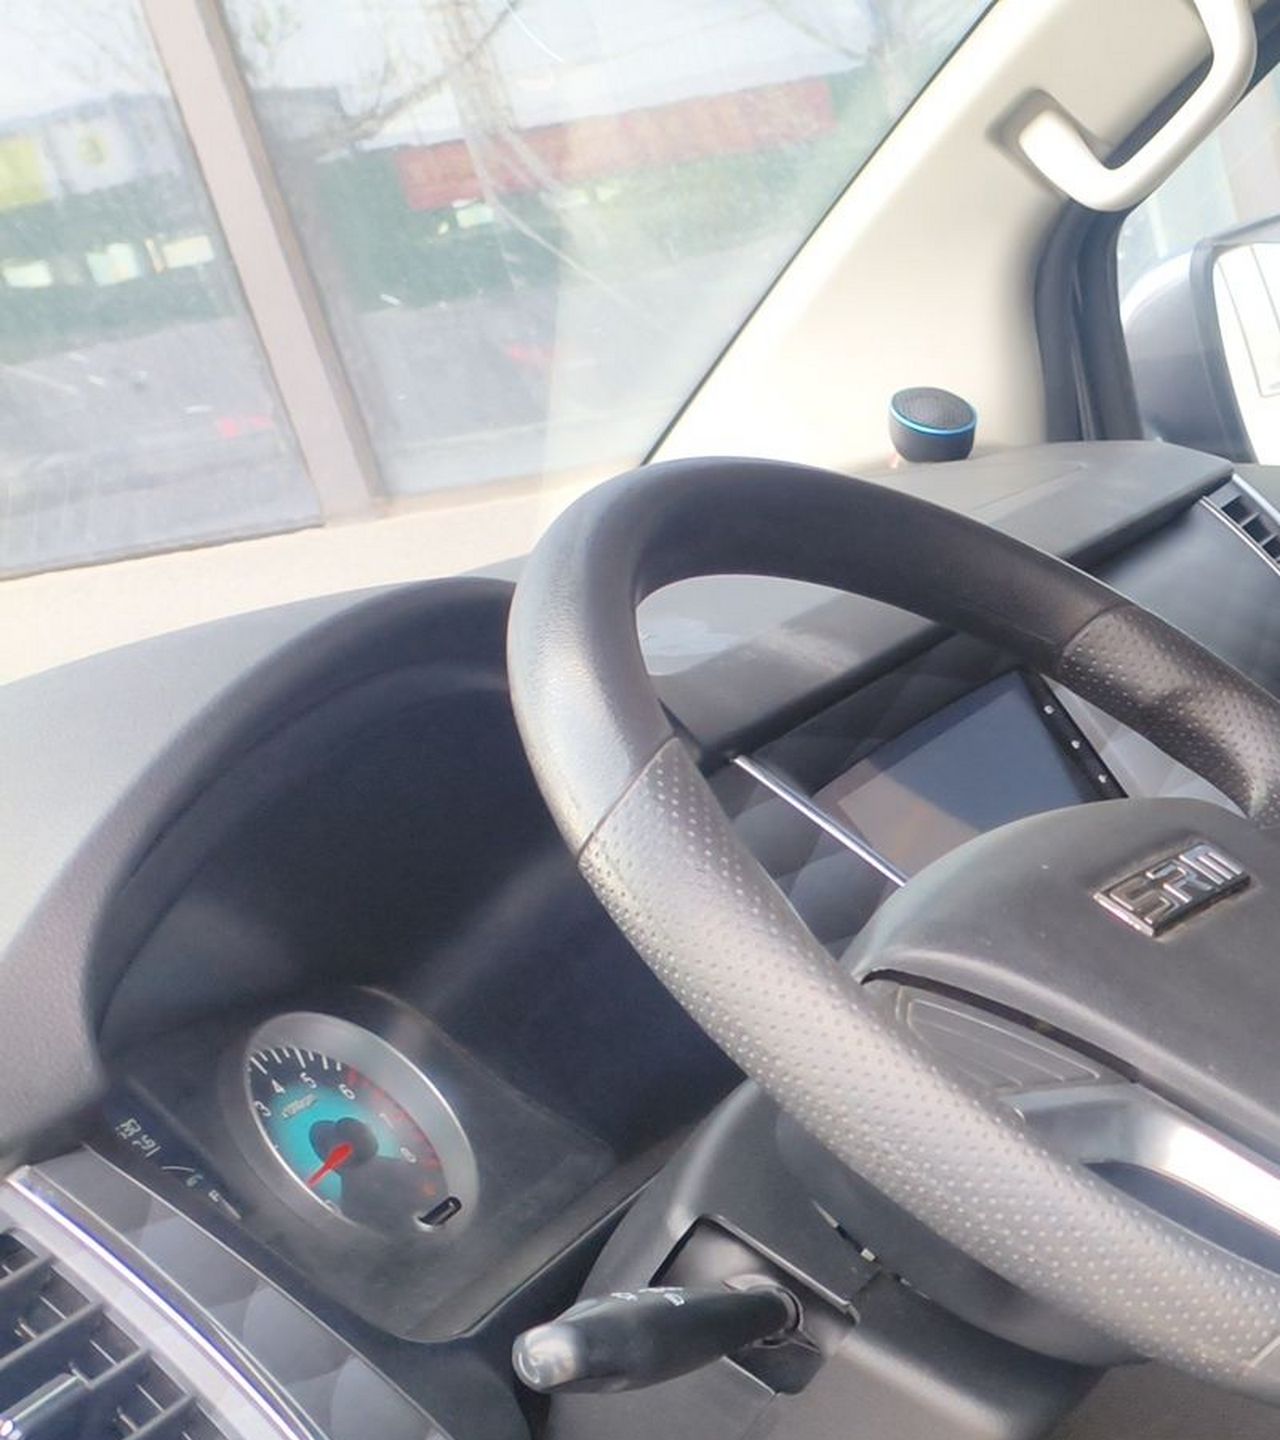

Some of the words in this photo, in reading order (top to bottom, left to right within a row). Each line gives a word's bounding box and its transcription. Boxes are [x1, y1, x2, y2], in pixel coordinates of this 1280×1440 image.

[271, 1079, 285, 1094] 4
[300, 1072, 317, 1089] 5
[339, 1084, 355, 1100] 6
